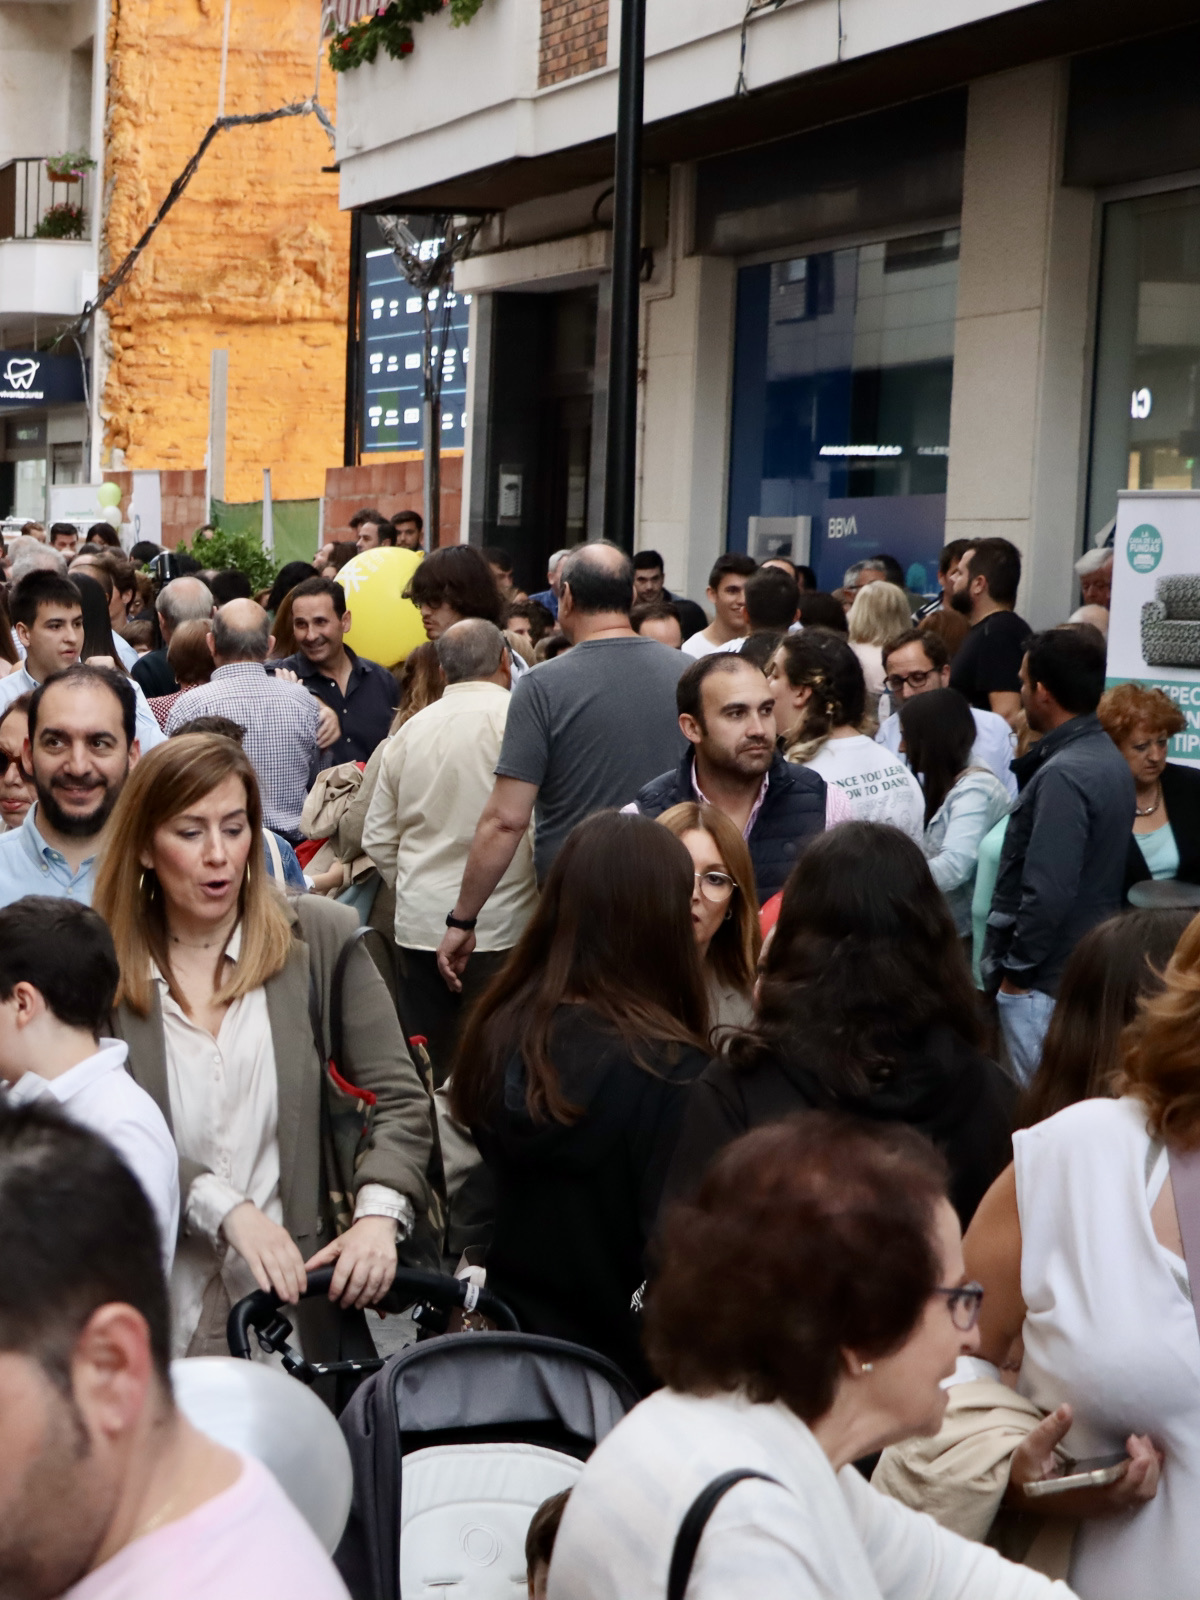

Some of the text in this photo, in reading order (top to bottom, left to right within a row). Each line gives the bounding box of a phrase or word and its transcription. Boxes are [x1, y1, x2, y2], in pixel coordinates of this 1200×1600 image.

[828, 516, 858, 538] BBVA
[1129, 544, 1160, 552] FUNDAS
[1173, 733, 1200, 752] TIP
[860, 770, 883, 784] YOU
[865, 785, 879, 796] TO
